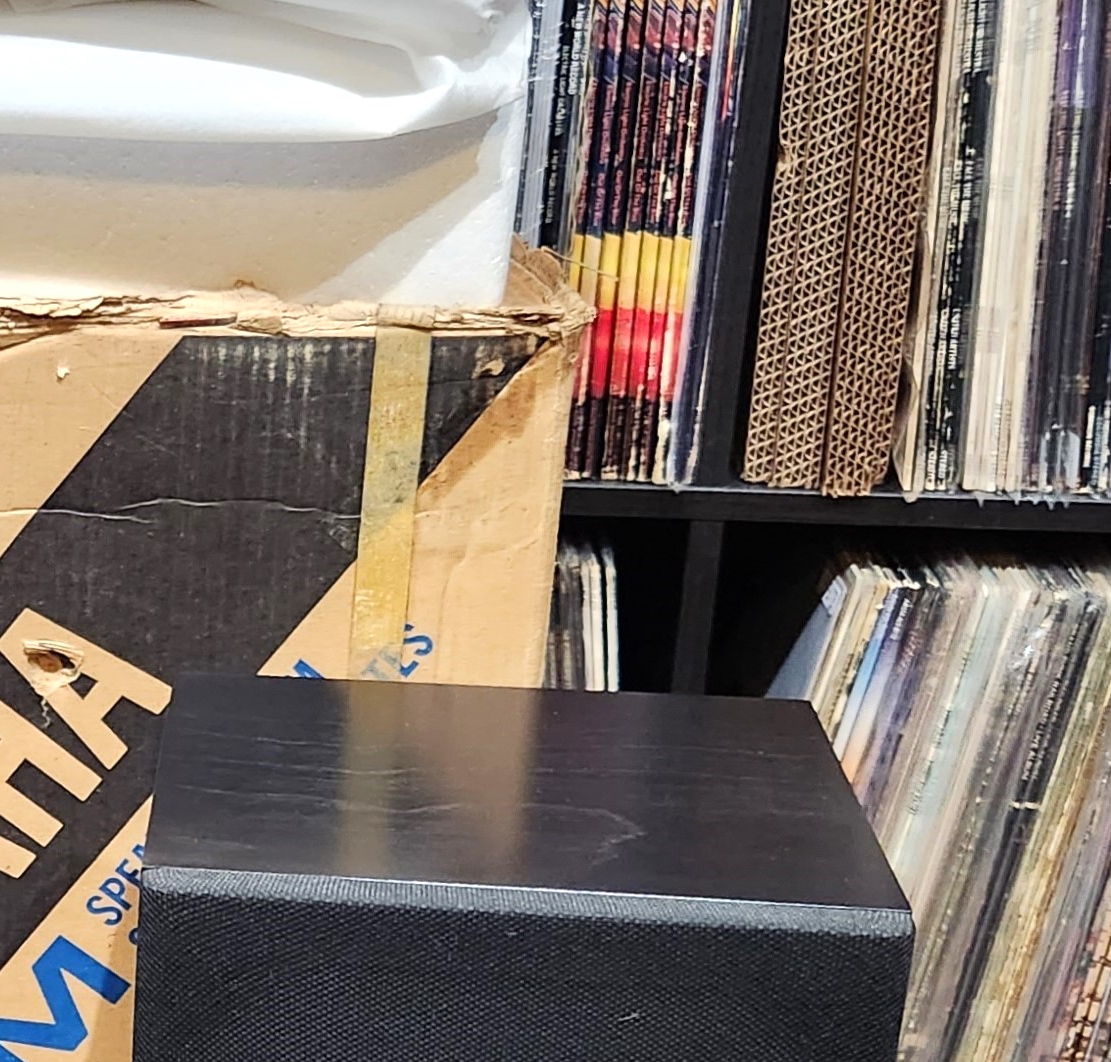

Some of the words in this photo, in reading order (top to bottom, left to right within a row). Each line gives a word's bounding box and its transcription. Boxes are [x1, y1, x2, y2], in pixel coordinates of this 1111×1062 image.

[571, 31, 583, 61] WORLD
[568, 61, 580, 95] RECORD
[640, 107, 649, 125] Light
